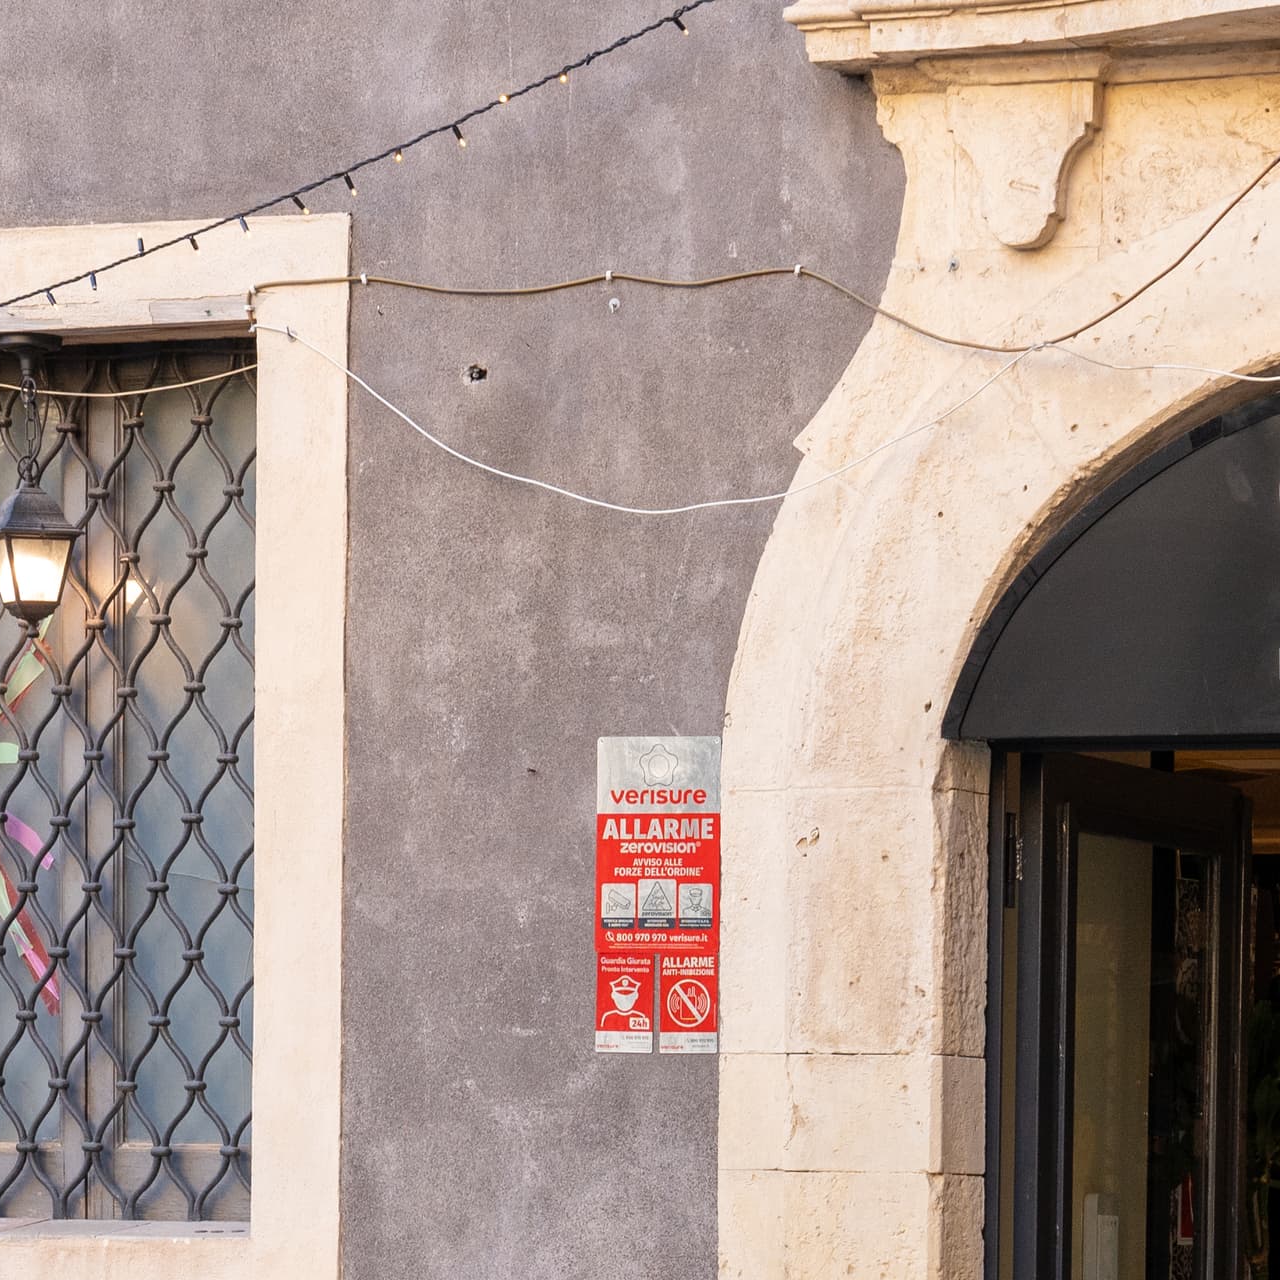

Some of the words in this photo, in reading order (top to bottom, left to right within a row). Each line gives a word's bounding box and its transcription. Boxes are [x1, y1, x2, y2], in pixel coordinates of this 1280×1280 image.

[610, 788, 707, 805] verisure
[602, 818, 715, 840] ALLARME
[633, 858, 662, 867] AVVISO
[664, 858, 683, 867] ALLE
[614, 867, 642, 877] FORZE
[616, 933, 633, 942] 800
[635, 933, 650, 942] 970
[652, 933, 667, 942] 970
[669, 933, 708, 942] verisure.it
[600, 957, 626, 965] Guardia
[627, 957, 651, 966] Giurata
[662, 956, 715, 968] ALLARME
[631, 1019, 648, 1028] 24h
